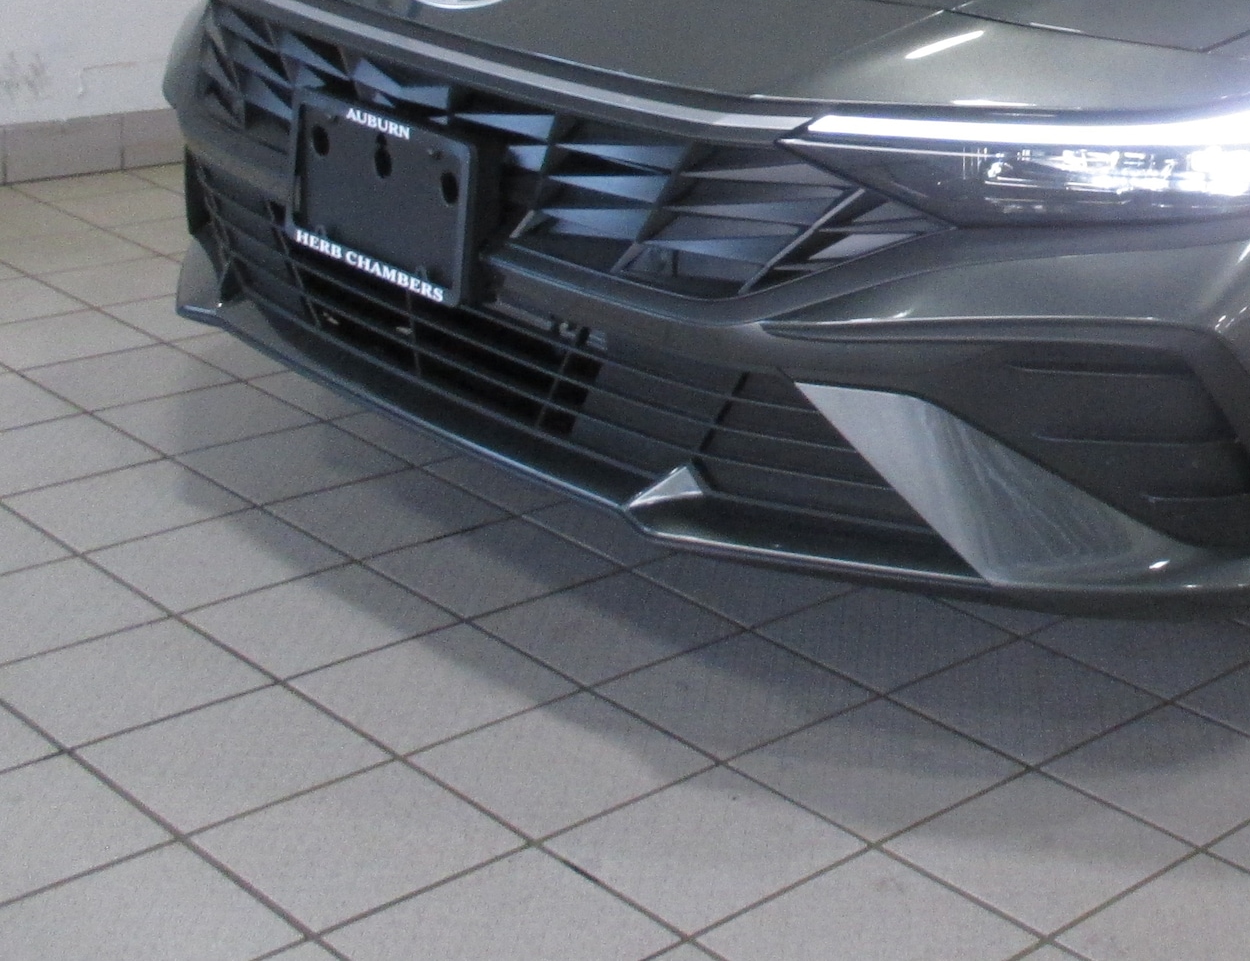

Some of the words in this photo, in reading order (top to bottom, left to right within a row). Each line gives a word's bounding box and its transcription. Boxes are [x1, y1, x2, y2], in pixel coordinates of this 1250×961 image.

[346, 108, 411, 140] AUBURN
[295, 229, 342, 260] HERB
[345, 251, 444, 303] CHAMBERS
